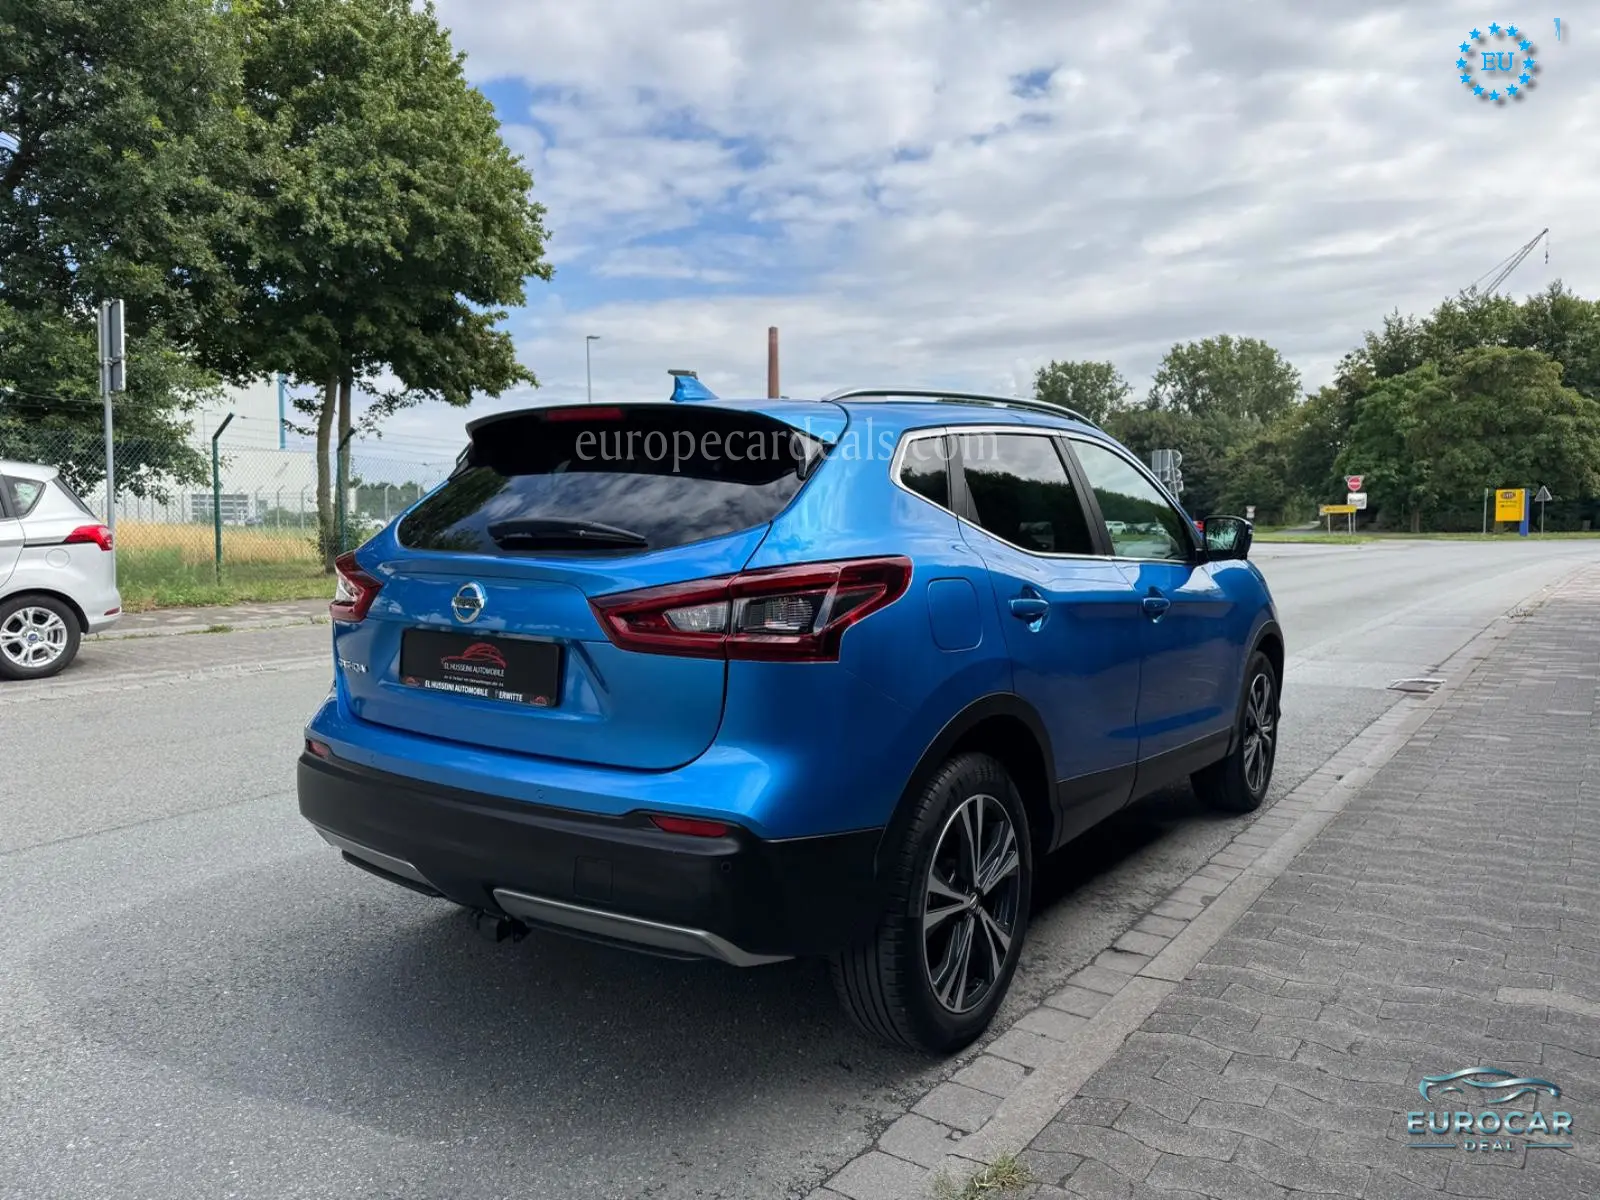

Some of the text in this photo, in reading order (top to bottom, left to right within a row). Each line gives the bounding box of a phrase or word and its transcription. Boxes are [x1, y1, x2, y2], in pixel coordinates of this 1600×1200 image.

[473, 666, 504, 677] AUTOMOBILE
[425, 680, 430, 688] EL
[431, 681, 455, 691] HUSSEINI
[455, 684, 488, 696] AUTOMOBILE
[499, 691, 523, 702] ERWITTE
